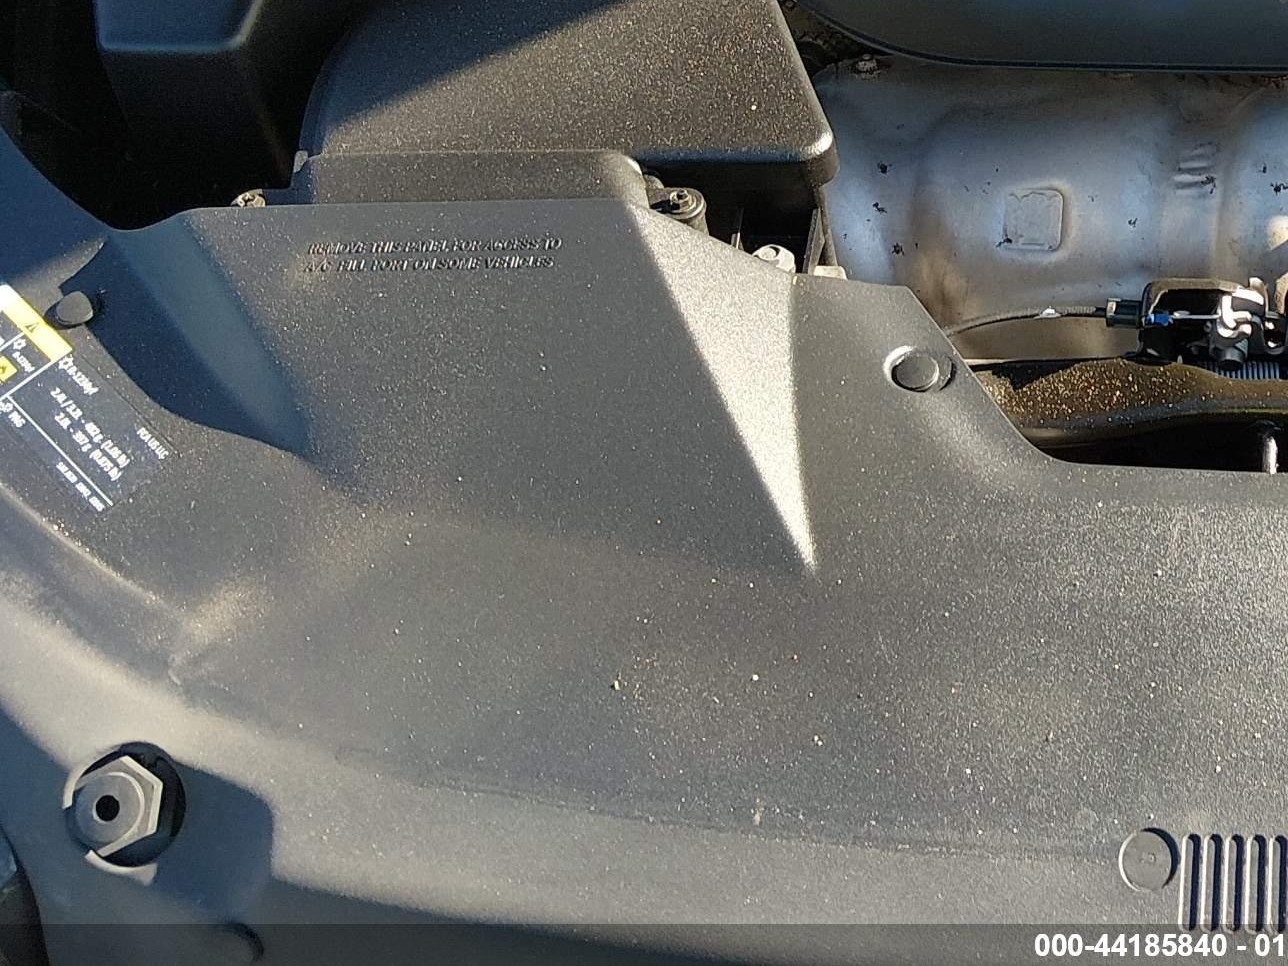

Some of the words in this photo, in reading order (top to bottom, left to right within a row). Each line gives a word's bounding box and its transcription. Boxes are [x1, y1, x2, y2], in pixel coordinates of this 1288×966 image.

[308, 241, 367, 255] REMOVE
[370, 240, 402, 254] THIS
[403, 238, 449, 253] PANEL
[453, 237, 482, 252] FOR
[484, 236, 541, 251] ACCESS
[543, 236, 562, 251] TO
[304, 257, 332, 272] A/C
[337, 257, 367, 272] FILL
[371, 256, 413, 272] PORT
[413, 256, 437, 271] ON
[437, 255, 482, 270] SOME
[485, 254, 555, 269] VEHICLES
[8, 411, 26, 427] PAG
[136, 427, 152, 442] FCA
[154, 446, 169, 459] LLC
